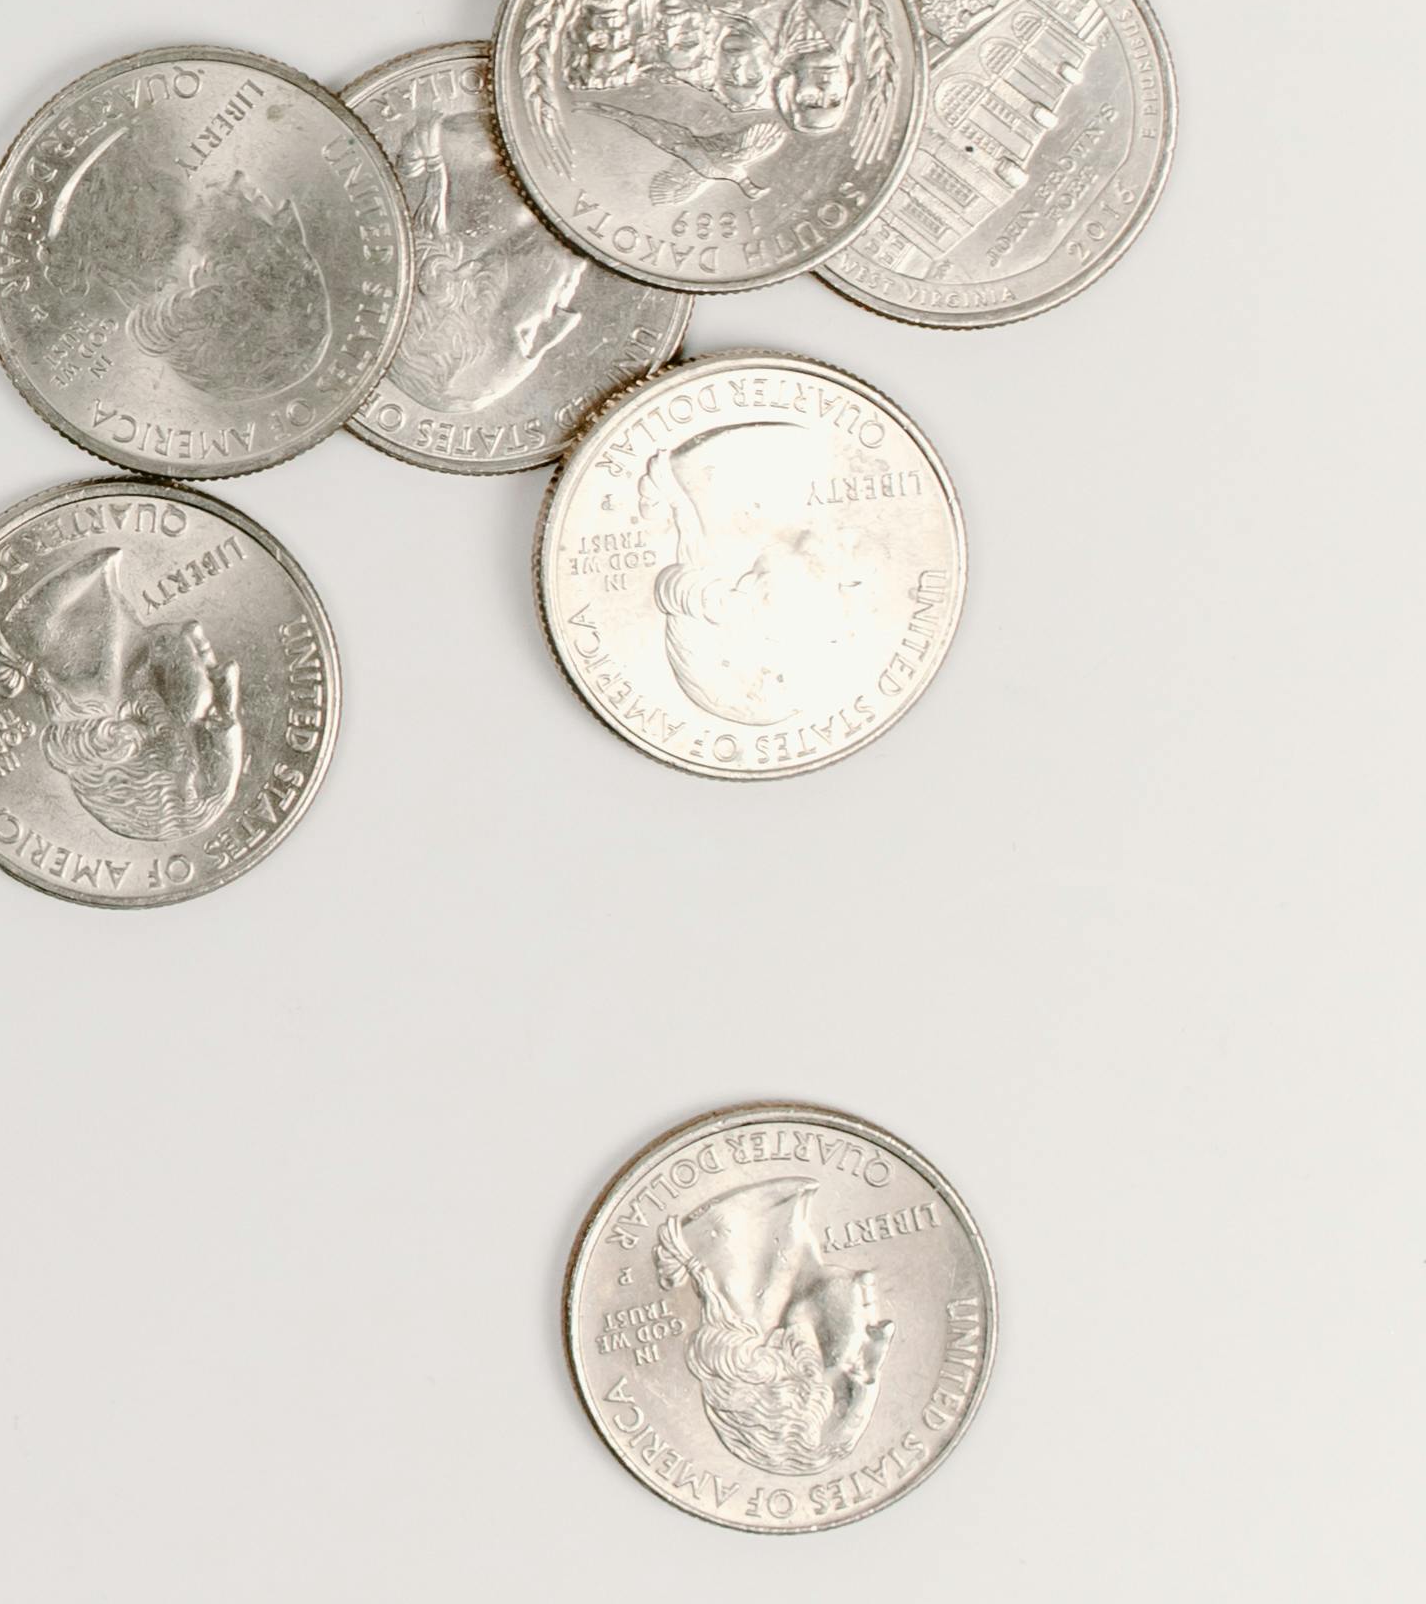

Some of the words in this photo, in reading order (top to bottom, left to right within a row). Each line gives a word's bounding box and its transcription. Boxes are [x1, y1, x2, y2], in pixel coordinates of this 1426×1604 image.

[35, 65, 206, 160] QUARTER
[174, 79, 265, 179] LIBERTY
[371, 65, 486, 123] OLLAR
[321, 142, 395, 264] UNITED
[571, 189, 719, 275] DAKOTA
[743, 182, 866, 268] SOUTH
[1068, 178, 1136, 262] 2016
[840, 254, 895, 295] WEST
[908, 278, 1017, 308] VIRGINIA
[91, 398, 256, 459] AMERICA
[415, 418, 547, 456] STATES
[594, 383, 722, 478] DOLLAR
[730, 376, 886, 449] QUARTER
[24, 501, 189, 555] QUARTER
[807, 471, 922, 505] LIBERTY
[141, 536, 248, 617] LIBERTY
[567, 602, 687, 744] AMERICA
[877, 568, 948, 698] UNITED
[276, 613, 323, 754] UNITED
[754, 693, 877, 764] STATES
[203, 760, 306, 868] STATES
[146, 853, 194, 888] OF
[604, 1148, 726, 1251] DOLLAR
[730, 1130, 893, 1188] QUARTER
[822, 1201, 941, 1254] LIBERTY
[601, 1299, 674, 1332] TRUST
[634, 1344, 661, 1367] IN
[641, 1318, 687, 1342] GOD
[922, 1296, 979, 1431] UNITED
[602, 1376, 741, 1510] AMERICA
[811, 1432, 928, 1516] STATES
[745, 1488, 794, 1520] OF
